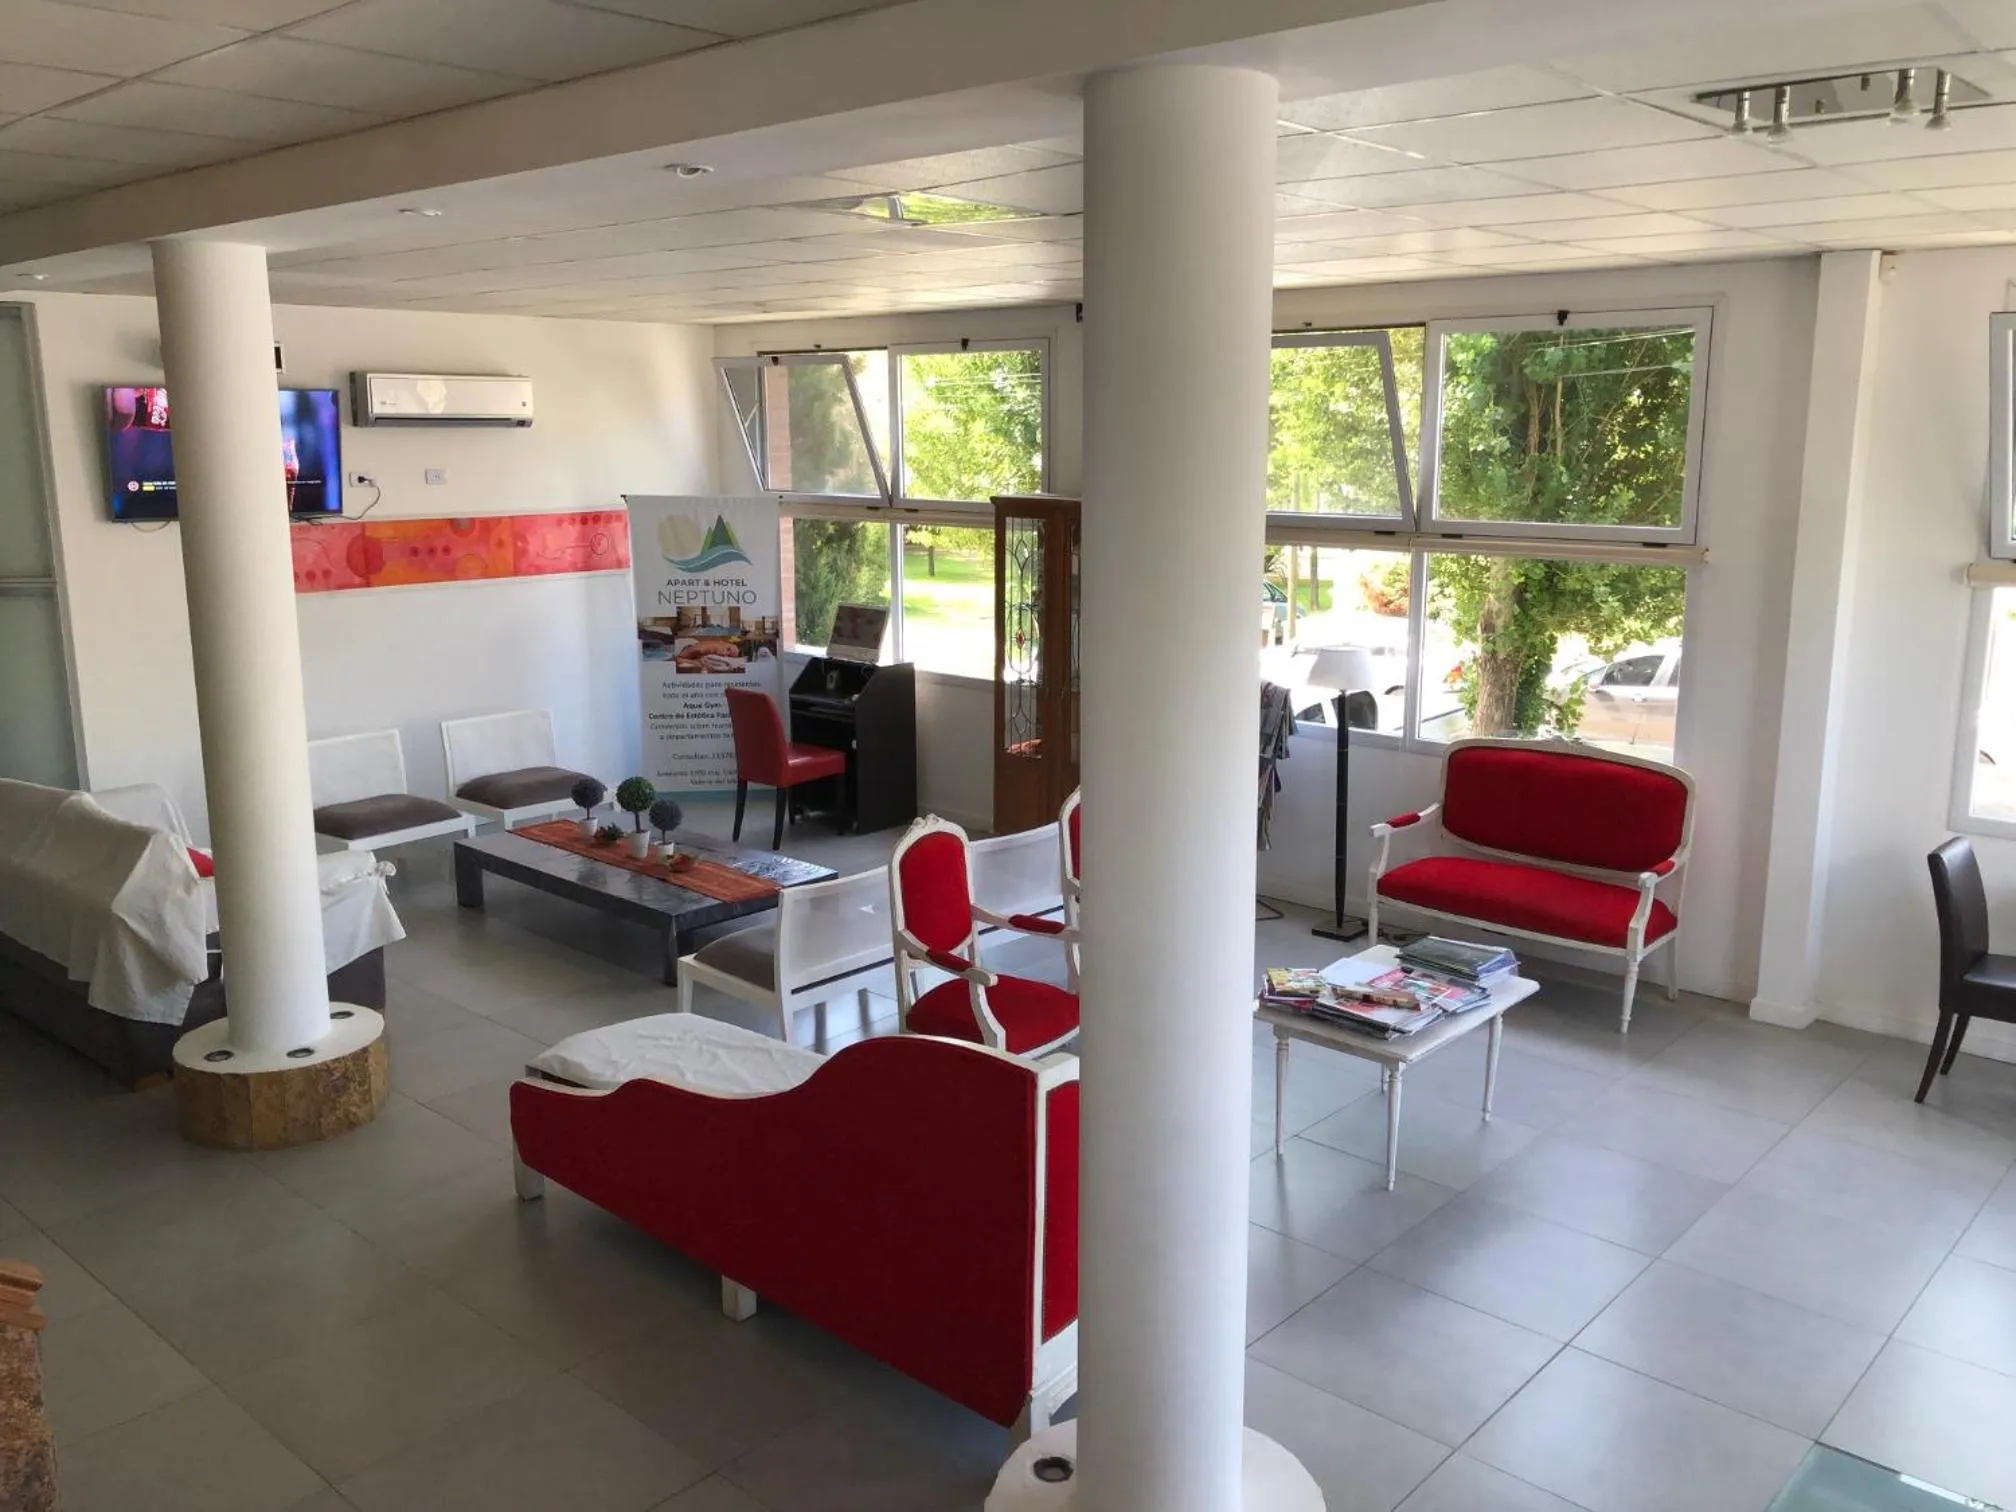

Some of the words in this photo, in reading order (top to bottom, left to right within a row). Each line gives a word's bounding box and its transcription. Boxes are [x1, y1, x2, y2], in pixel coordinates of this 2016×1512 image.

[666, 578, 700, 587] APART
[703, 578, 710, 587] &
[713, 578, 748, 587] HOTEL
[657, 589, 757, 605] NEPTUNO
